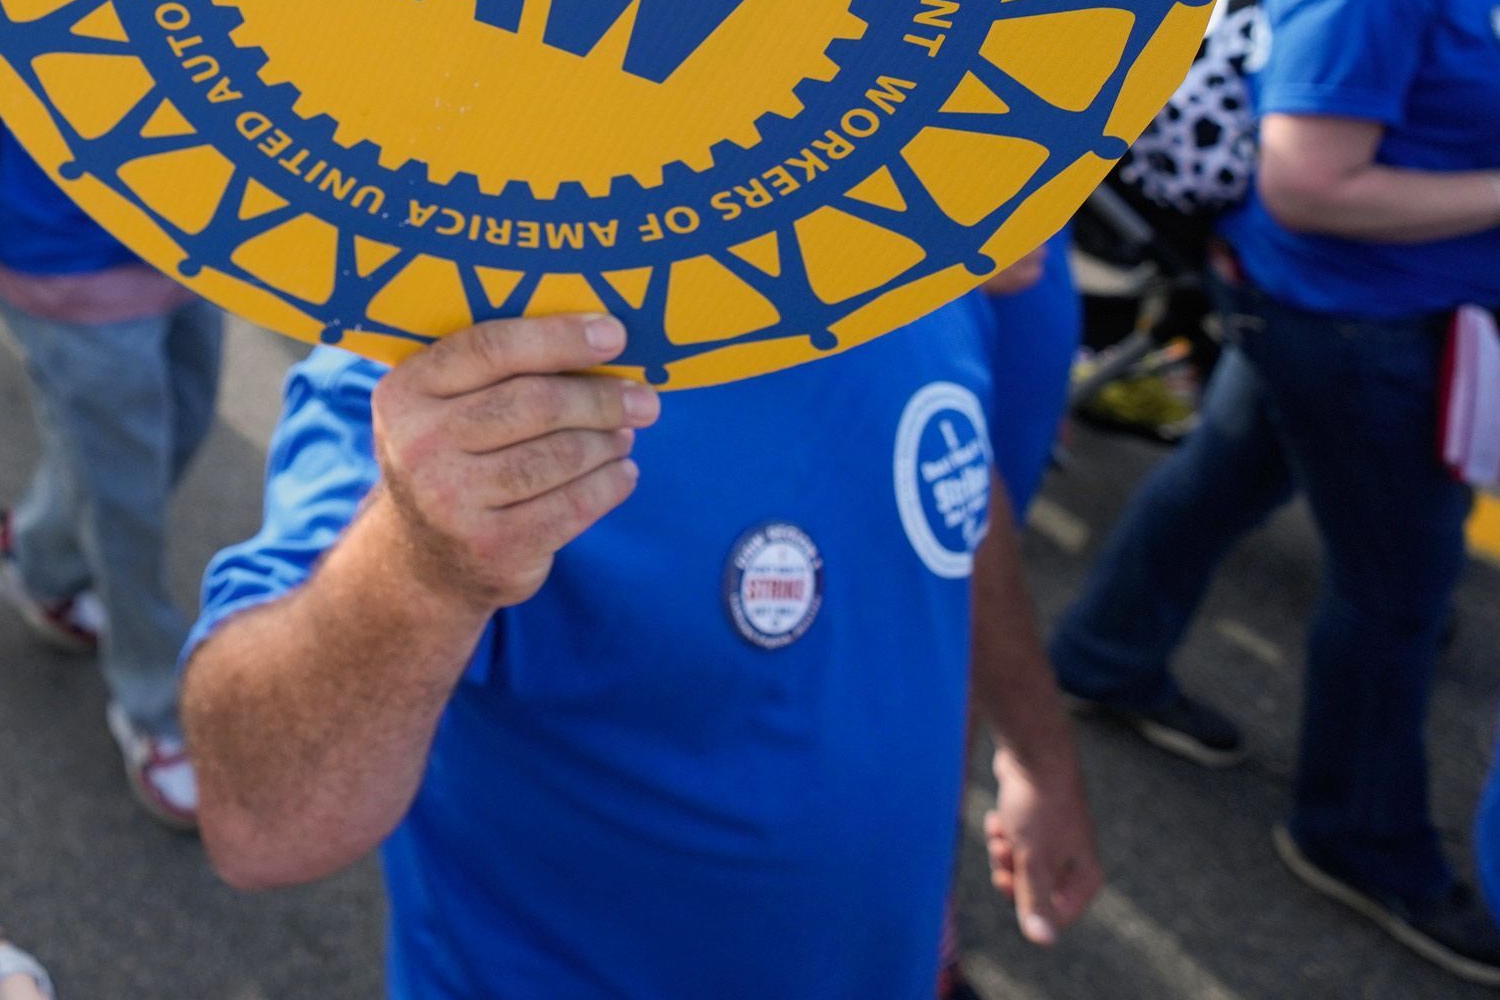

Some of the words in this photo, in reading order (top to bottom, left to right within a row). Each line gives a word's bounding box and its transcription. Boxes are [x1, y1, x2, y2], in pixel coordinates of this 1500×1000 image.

[235, 111, 386, 215] UNITED
[710, 75, 917, 221] WORKERS
[408, 199, 619, 250] AMERICA
[638, 205, 701, 243] OF
